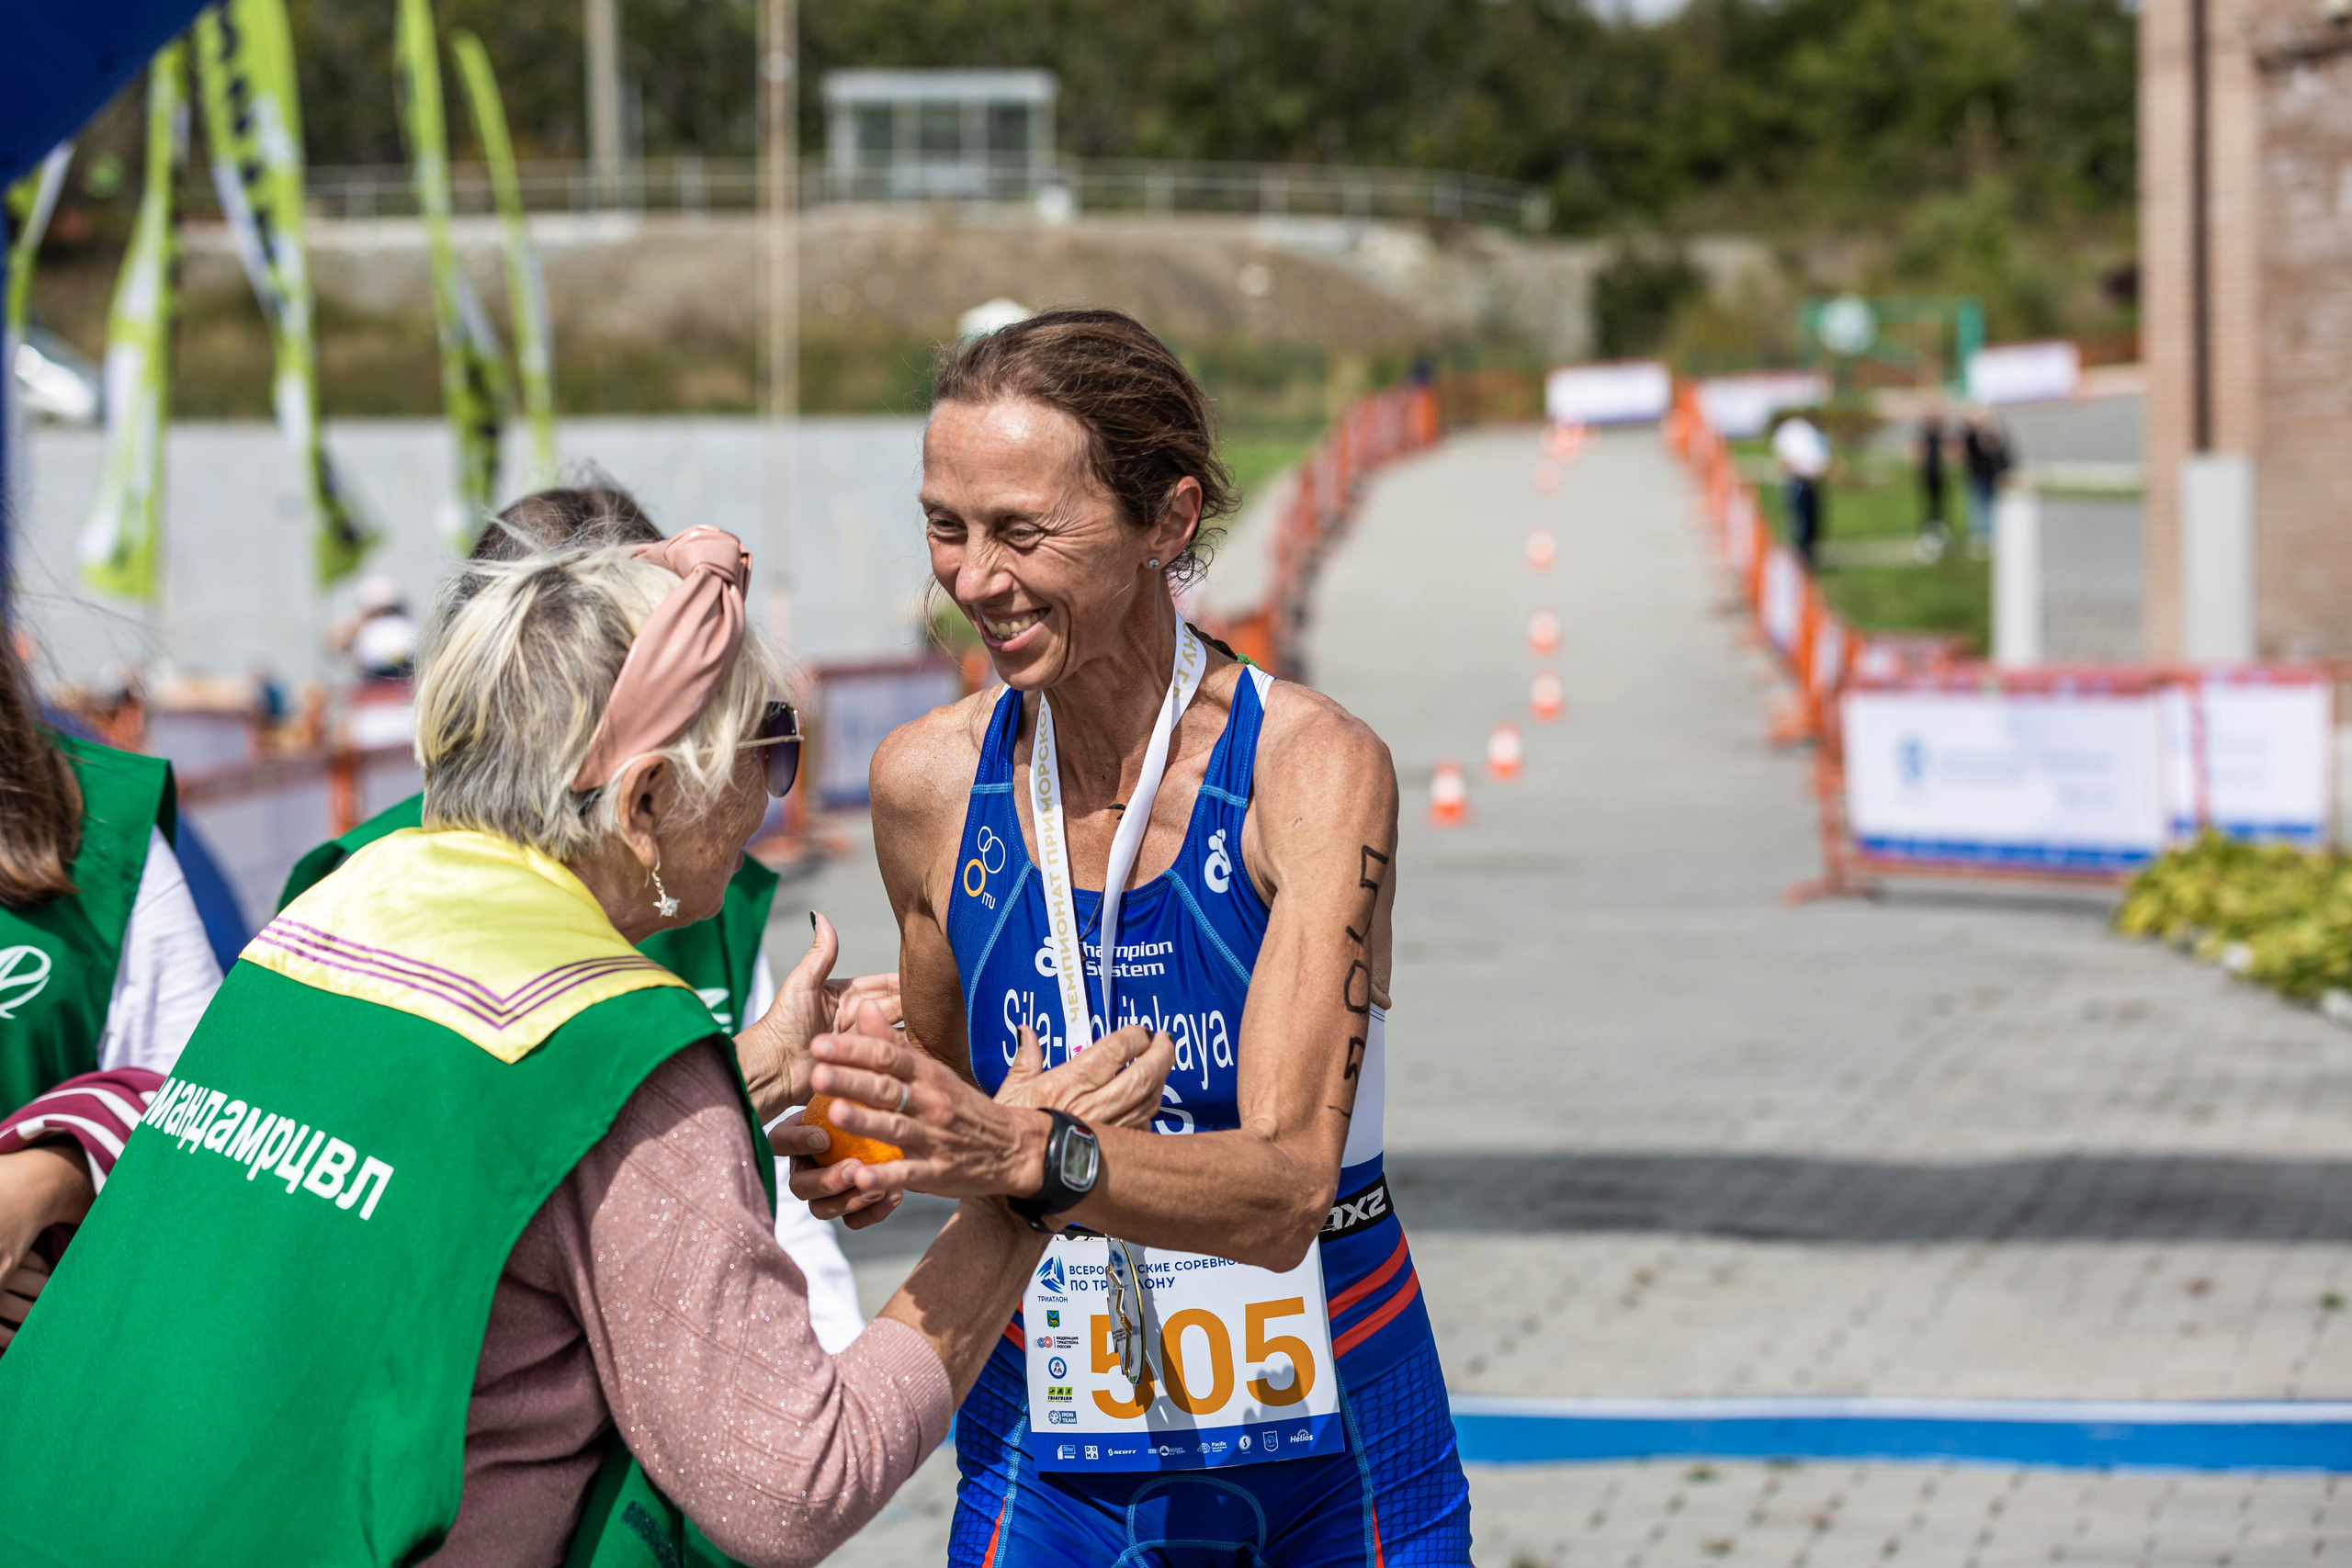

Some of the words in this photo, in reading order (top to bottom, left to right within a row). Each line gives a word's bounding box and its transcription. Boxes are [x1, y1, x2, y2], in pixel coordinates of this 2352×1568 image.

[981, 891, 996, 909] ITU
[1049, 874, 1080, 1023] ЧЕМПИОНАТ
[1080, 941, 1173, 962] hampion
[1070, 1280, 1088, 1292] ПО
[1091, 1296, 1316, 1419] 505
[1290, 1433, 1314, 1443] Helios
